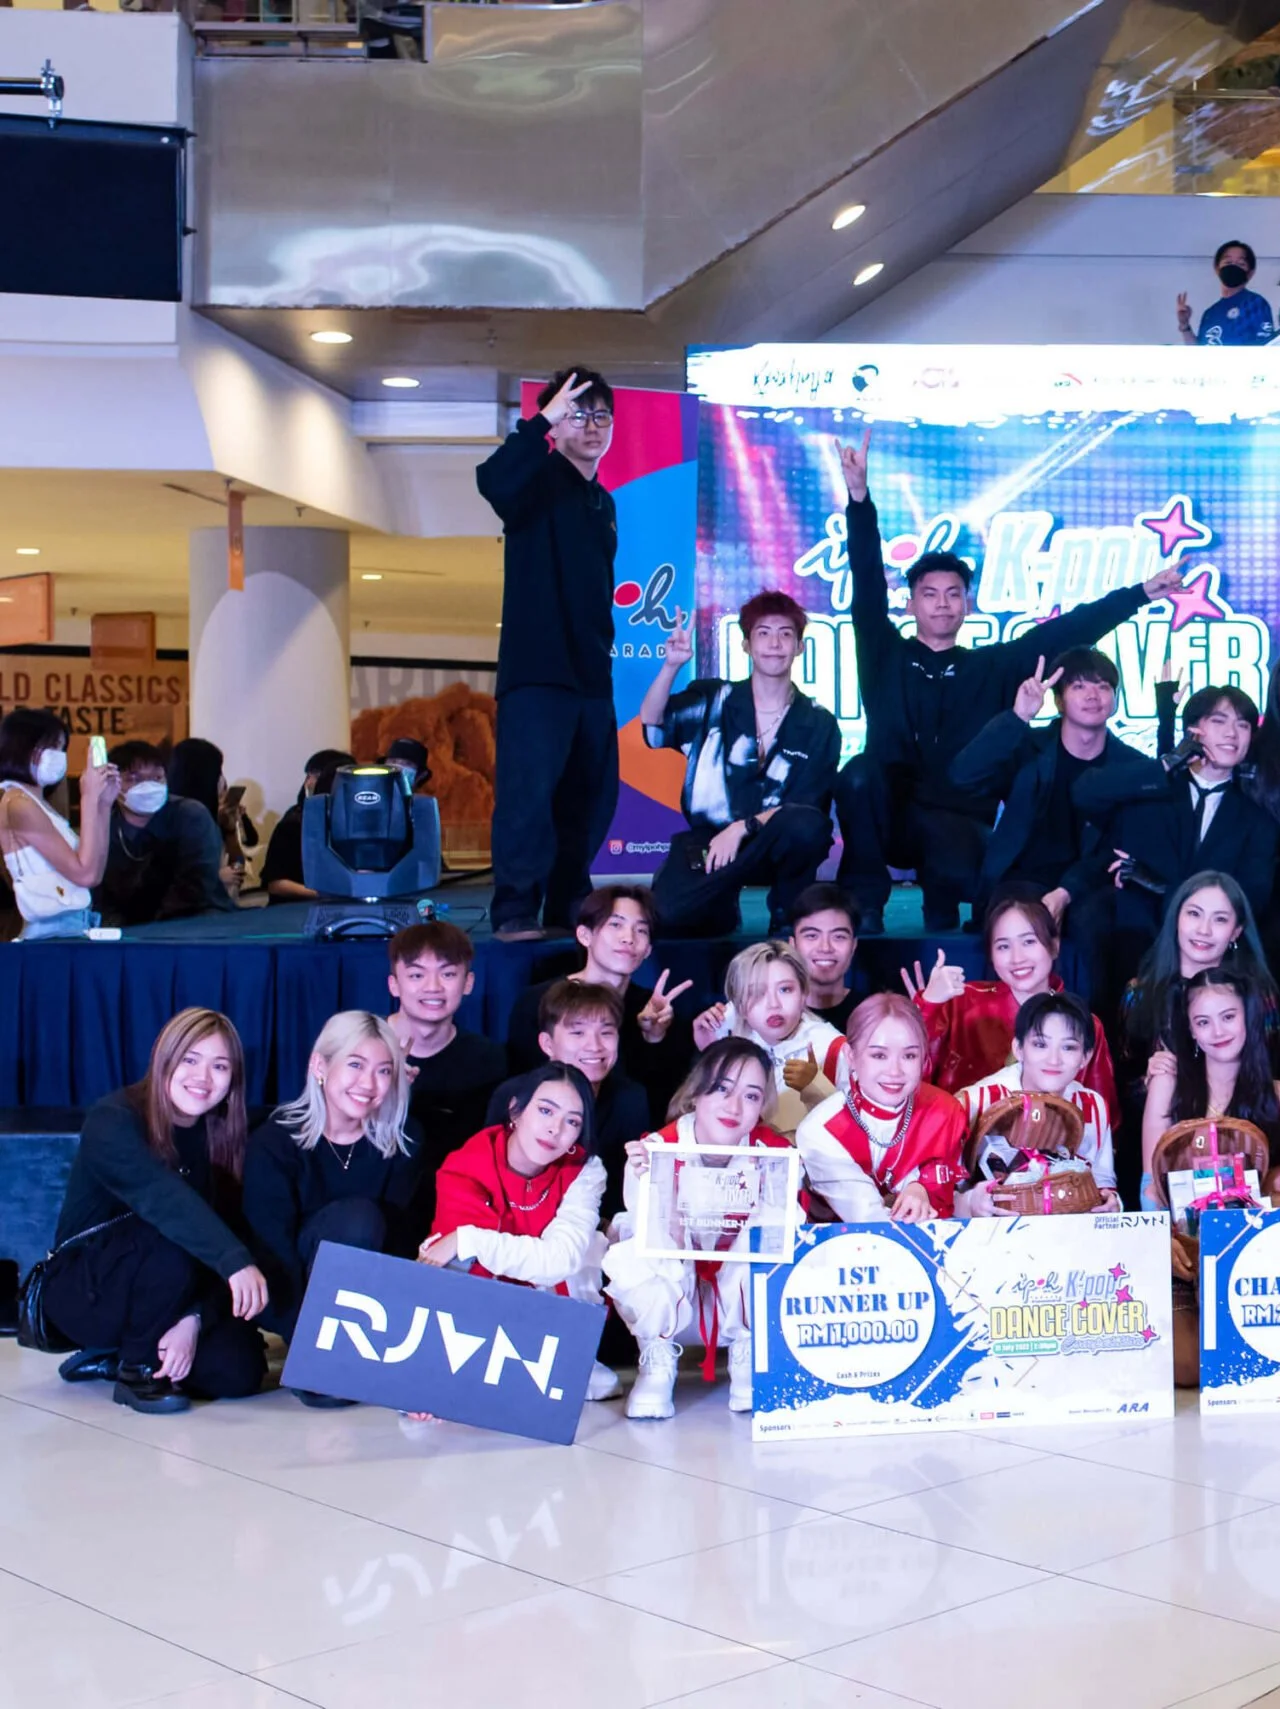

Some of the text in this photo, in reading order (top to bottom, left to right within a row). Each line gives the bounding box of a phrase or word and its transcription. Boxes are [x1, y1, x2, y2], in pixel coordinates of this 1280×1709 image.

[45, 672, 181, 705] CLASSICS
[838, 1266, 879, 1285] 1ST
[785, 1291, 930, 1316] RUNNER UP
[990, 1300, 1145, 1340] DANCE COVER
[859, 1370, 881, 1378] Prizes
[1117, 1402, 1149, 1414] ARA
[1207, 1399, 1237, 1407] Sponsors
[760, 1422, 791, 1433] Sponsors
